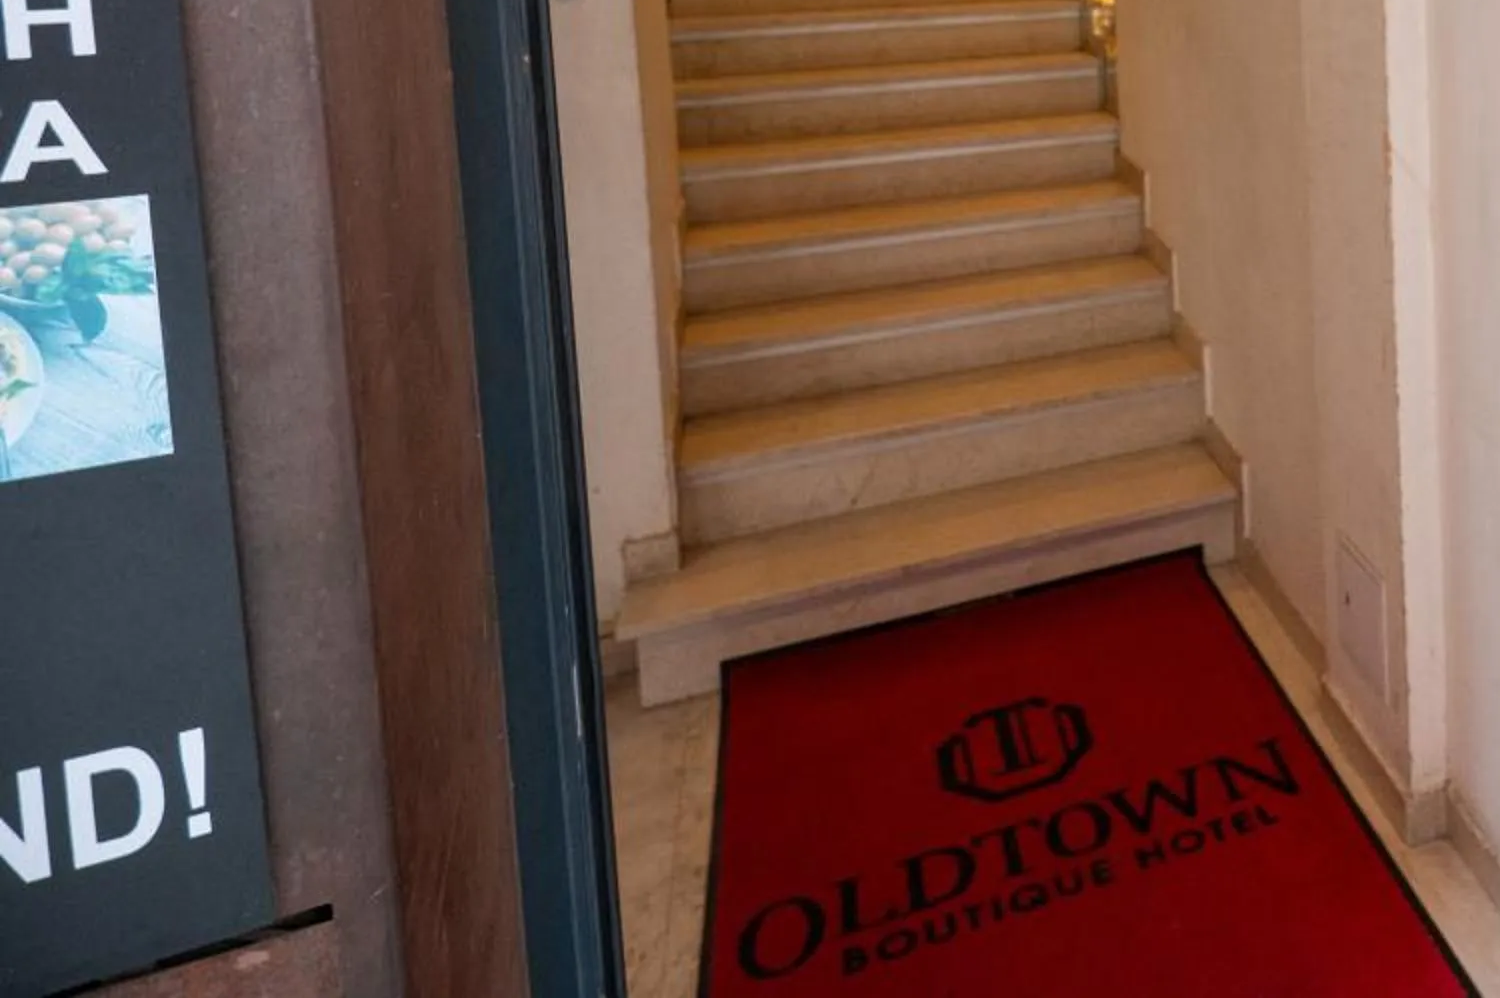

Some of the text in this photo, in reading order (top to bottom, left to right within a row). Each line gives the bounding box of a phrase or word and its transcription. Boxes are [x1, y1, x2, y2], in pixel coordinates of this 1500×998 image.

[736, 736, 1302, 981] OLDTOWN
[841, 804, 1281, 977] BOUTIQUE HOTEL
